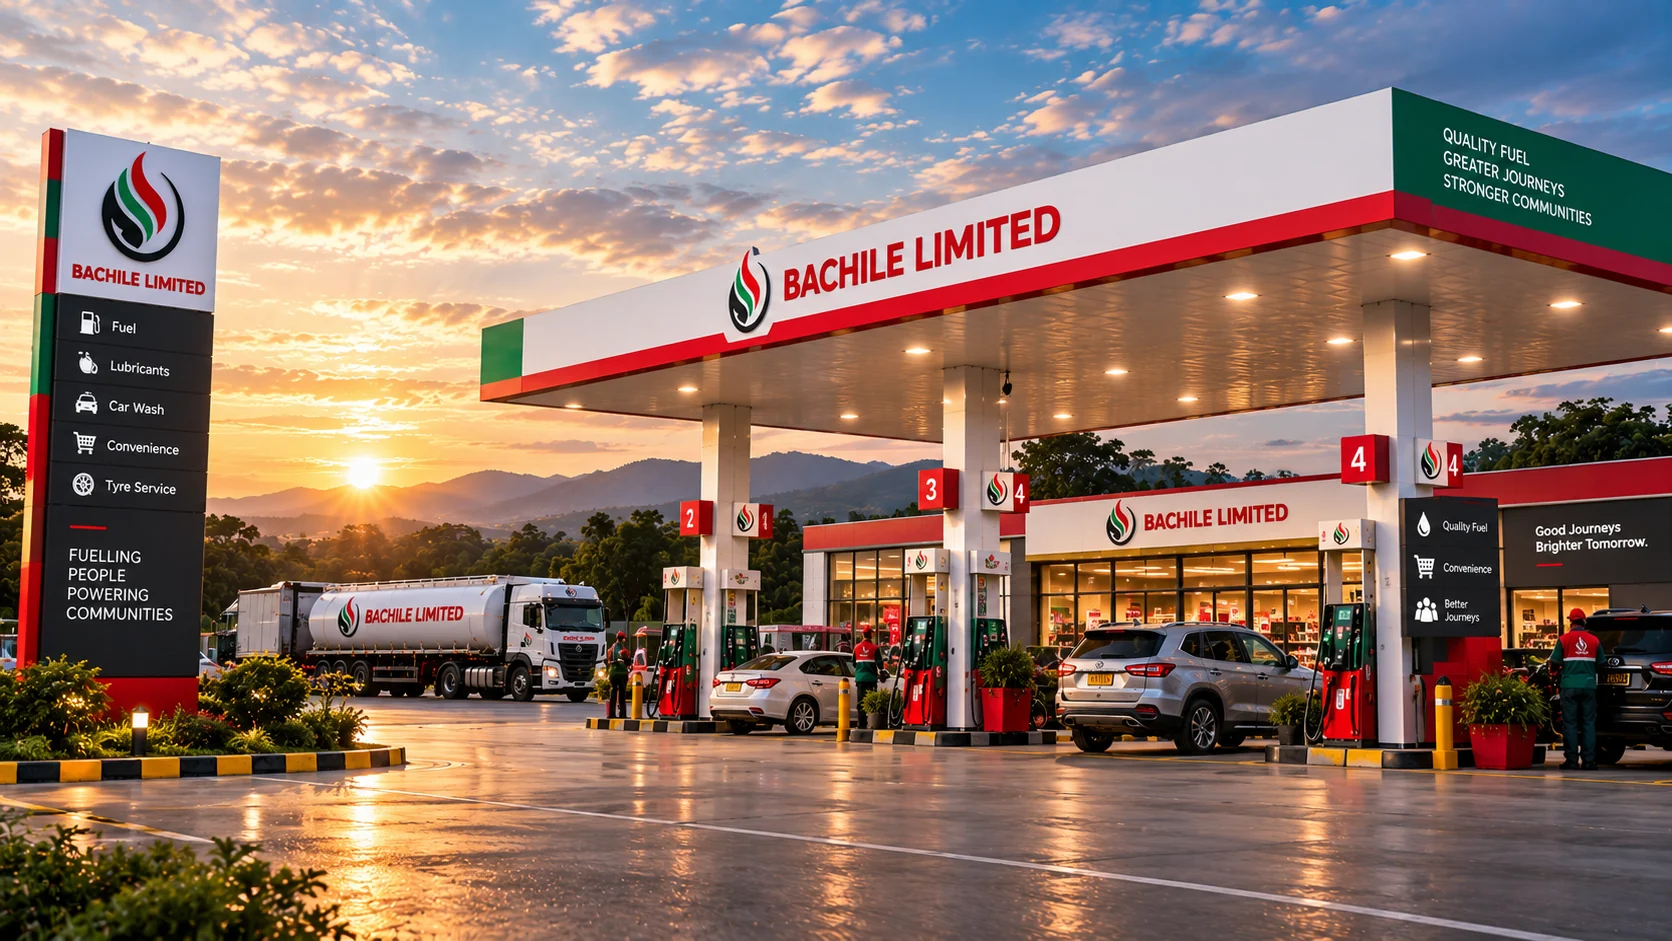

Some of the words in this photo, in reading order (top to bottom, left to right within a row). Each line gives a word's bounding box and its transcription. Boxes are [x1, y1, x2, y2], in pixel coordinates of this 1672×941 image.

[1443, 127, 1497, 155] QUALITY
[1500, 144, 1530, 166] FUEL
[1443, 150, 1499, 179] GREATER
[1502, 168, 1565, 197] JOURNEYS
[1443, 174, 1509, 204] STRONGER
[1512, 193, 1592, 226] COMMUNITIES
[784, 241, 904, 301] BACHILE
[915, 205, 1061, 272] LIMITED
[71, 263, 140, 287] BACHILE
[144, 273, 206, 296] LIMITED
[112, 321, 137, 335] Fuel
[110, 360, 170, 377] Lubricants
[109, 400, 130, 413] Car
[133, 402, 165, 416] Wash
[107, 440, 180, 456] Convenience
[1350, 446, 1367, 472] 4
[1448, 454, 1459, 477] 4
[105, 479, 131, 494] Tyre
[134, 481, 177, 495] Service
[925, 478, 937, 501] 3
[1014, 483, 1026, 504] 4
[685, 508, 695, 528] 2
[1144, 507, 1213, 531] BACHILE
[1217, 503, 1289, 526] LIMITED
[1472, 522, 1488, 533] Fuel
[1535, 524, 1566, 537] Good
[1568, 523, 1621, 536] Journeys
[1536, 539, 1583, 554] Brighter
[1585, 537, 1648, 550] Tomorrow.
[69, 548, 142, 564] FUELLING
[68, 567, 126, 582] PEOPLE
[1443, 562, 1493, 575] Convenience
[67, 586, 149, 602] POWERING
[1444, 598, 1469, 609] Better
[66, 606, 173, 622] COMMUNITIES
[365, 607, 412, 624] BACHILE
[415, 605, 464, 622] LIMITED
[1444, 611, 1480, 624] Journeys
